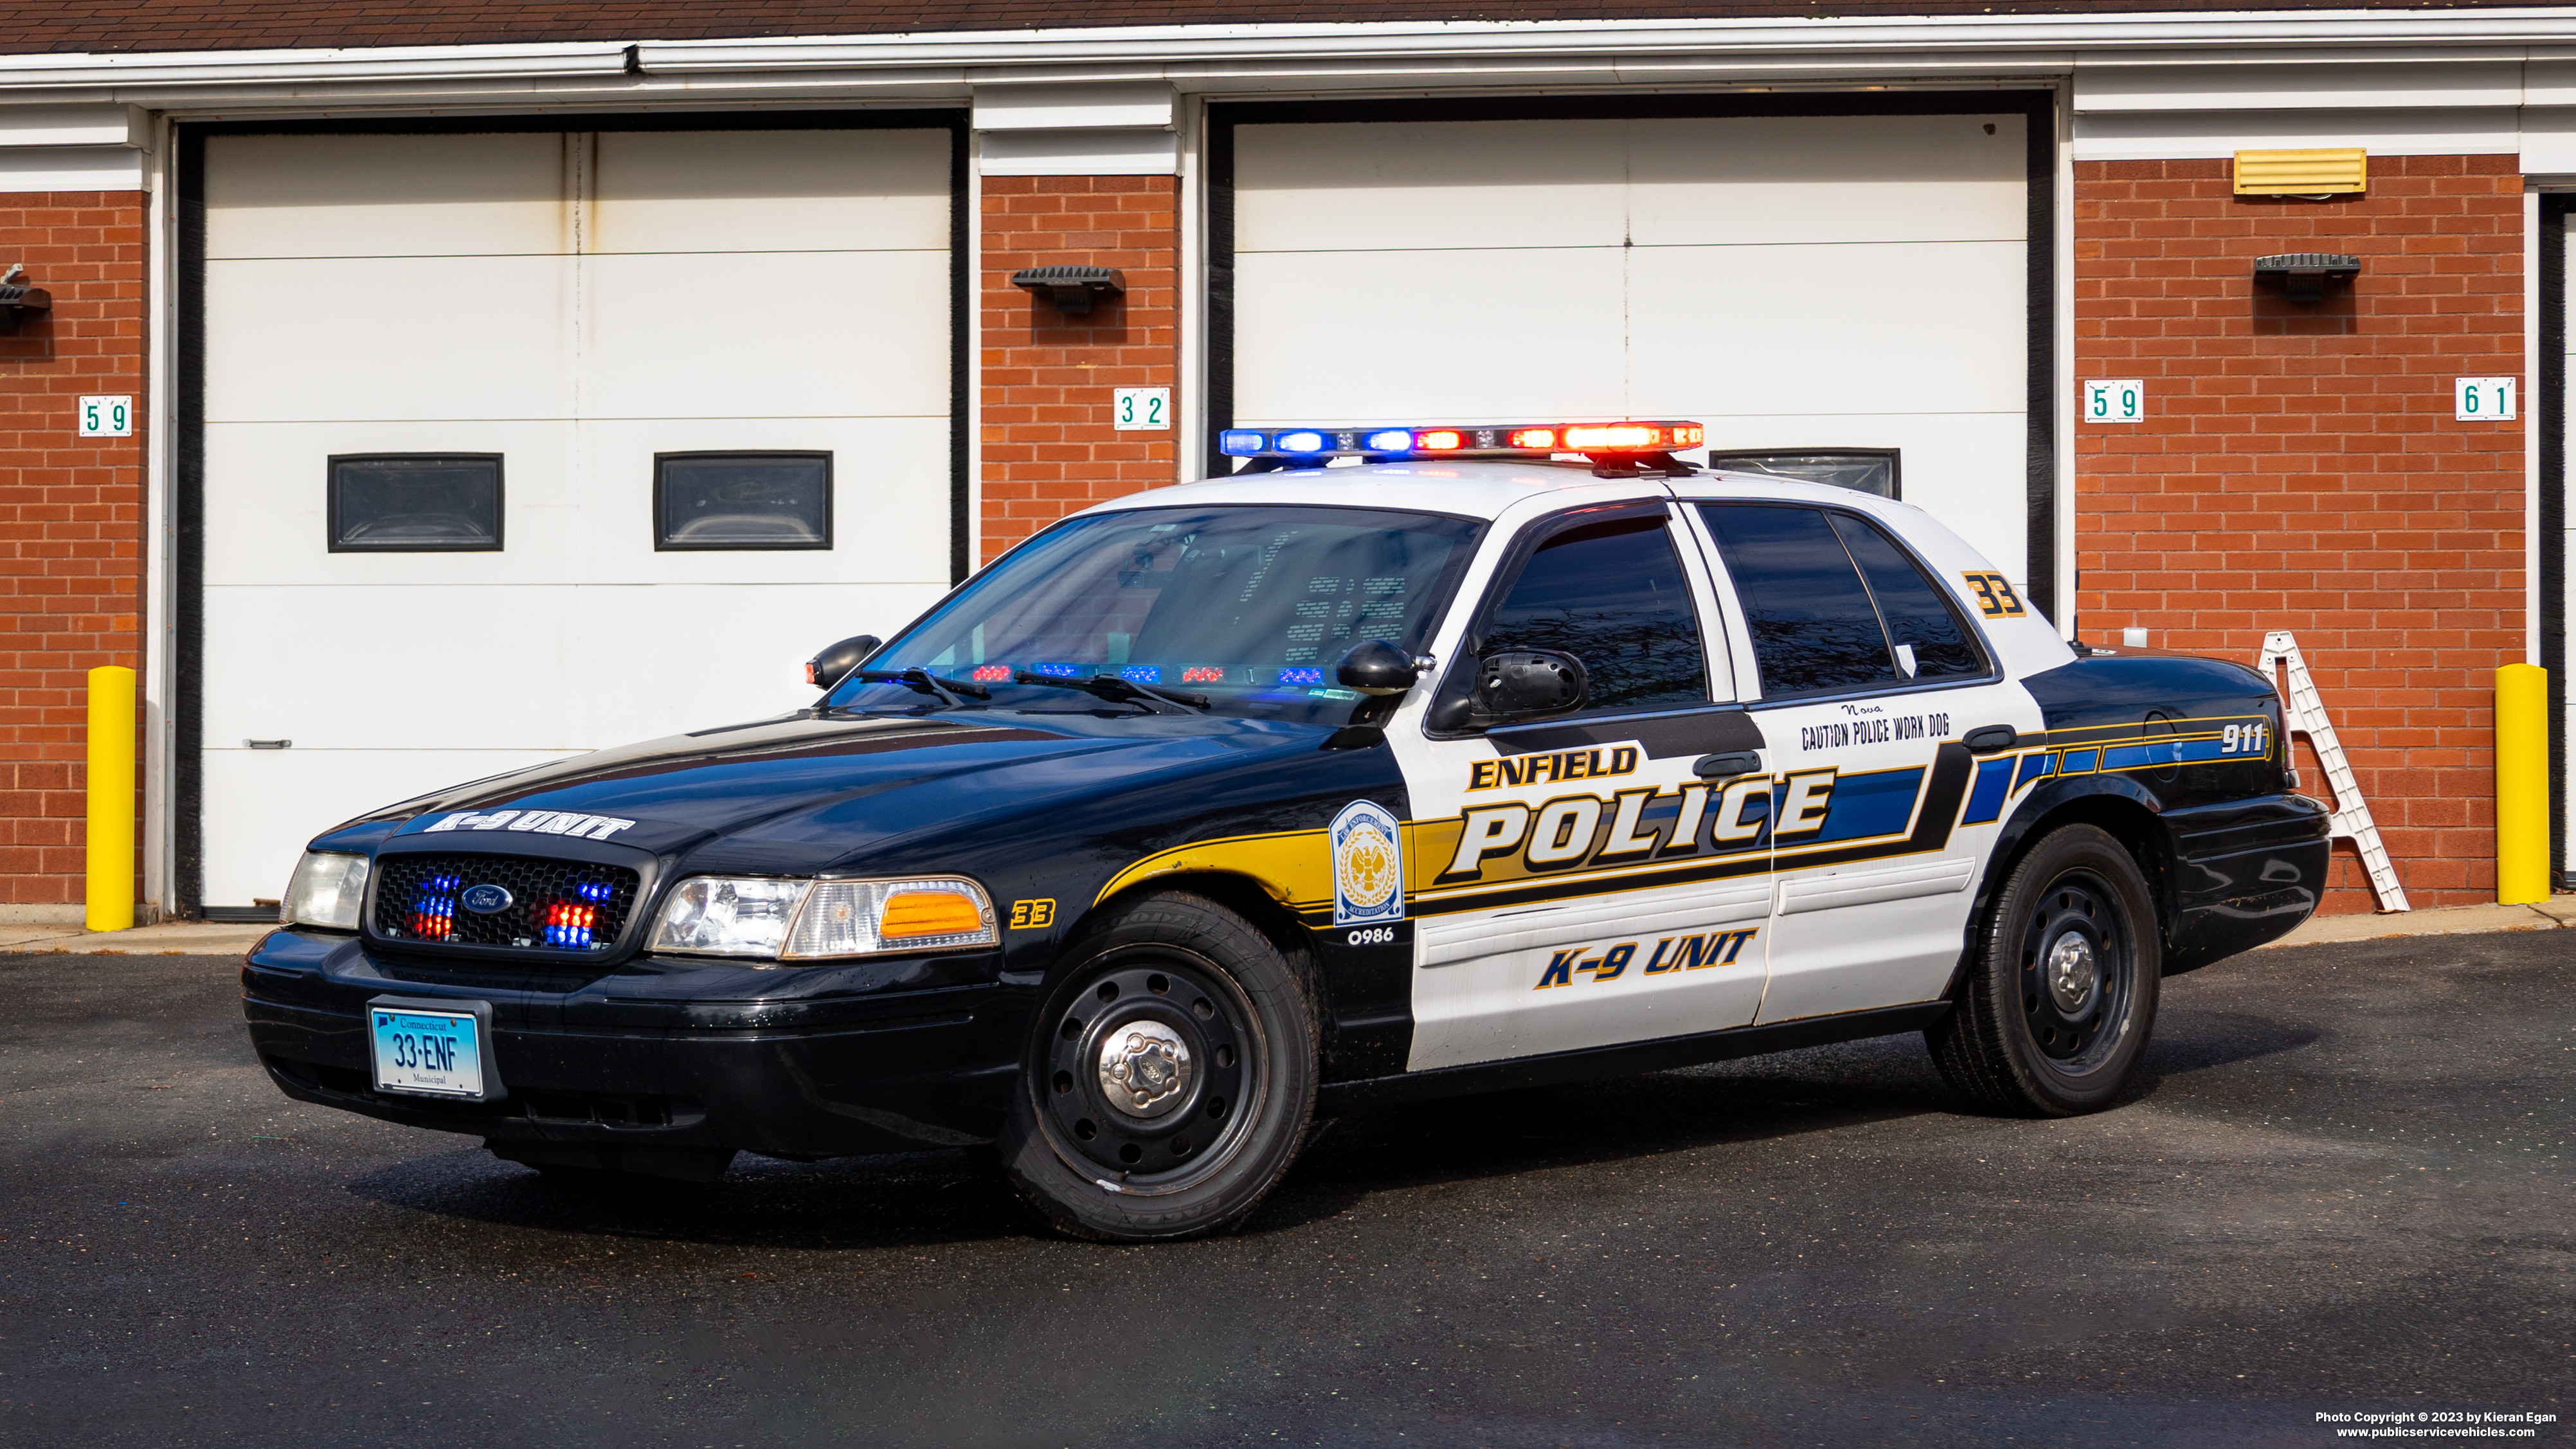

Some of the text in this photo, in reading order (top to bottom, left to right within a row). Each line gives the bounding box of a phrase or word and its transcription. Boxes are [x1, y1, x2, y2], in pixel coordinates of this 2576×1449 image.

[1959, 570, 2027, 619] 33
[1841, 705, 1883, 716] Nova
[1801, 712, 1949, 751] CAUTION POLICE WORK DOG
[2222, 723, 2263, 753] 911
[1464, 745, 1639, 793] ENFIELD
[424, 810, 636, 840] K-9 UNIT
[1340, 814, 1389, 843] LAW ENFORCEMENT
[1435, 766, 1839, 885] POLICE
[471, 890, 500, 907] Ford
[1010, 898, 1056, 929] 33
[1348, 901, 1391, 916] ACCREDITATION
[1533, 926, 1760, 990] K-9 UNIT
[401, 1018, 447, 1031] Connecticut
[413, 1073, 446, 1084] Municipal
